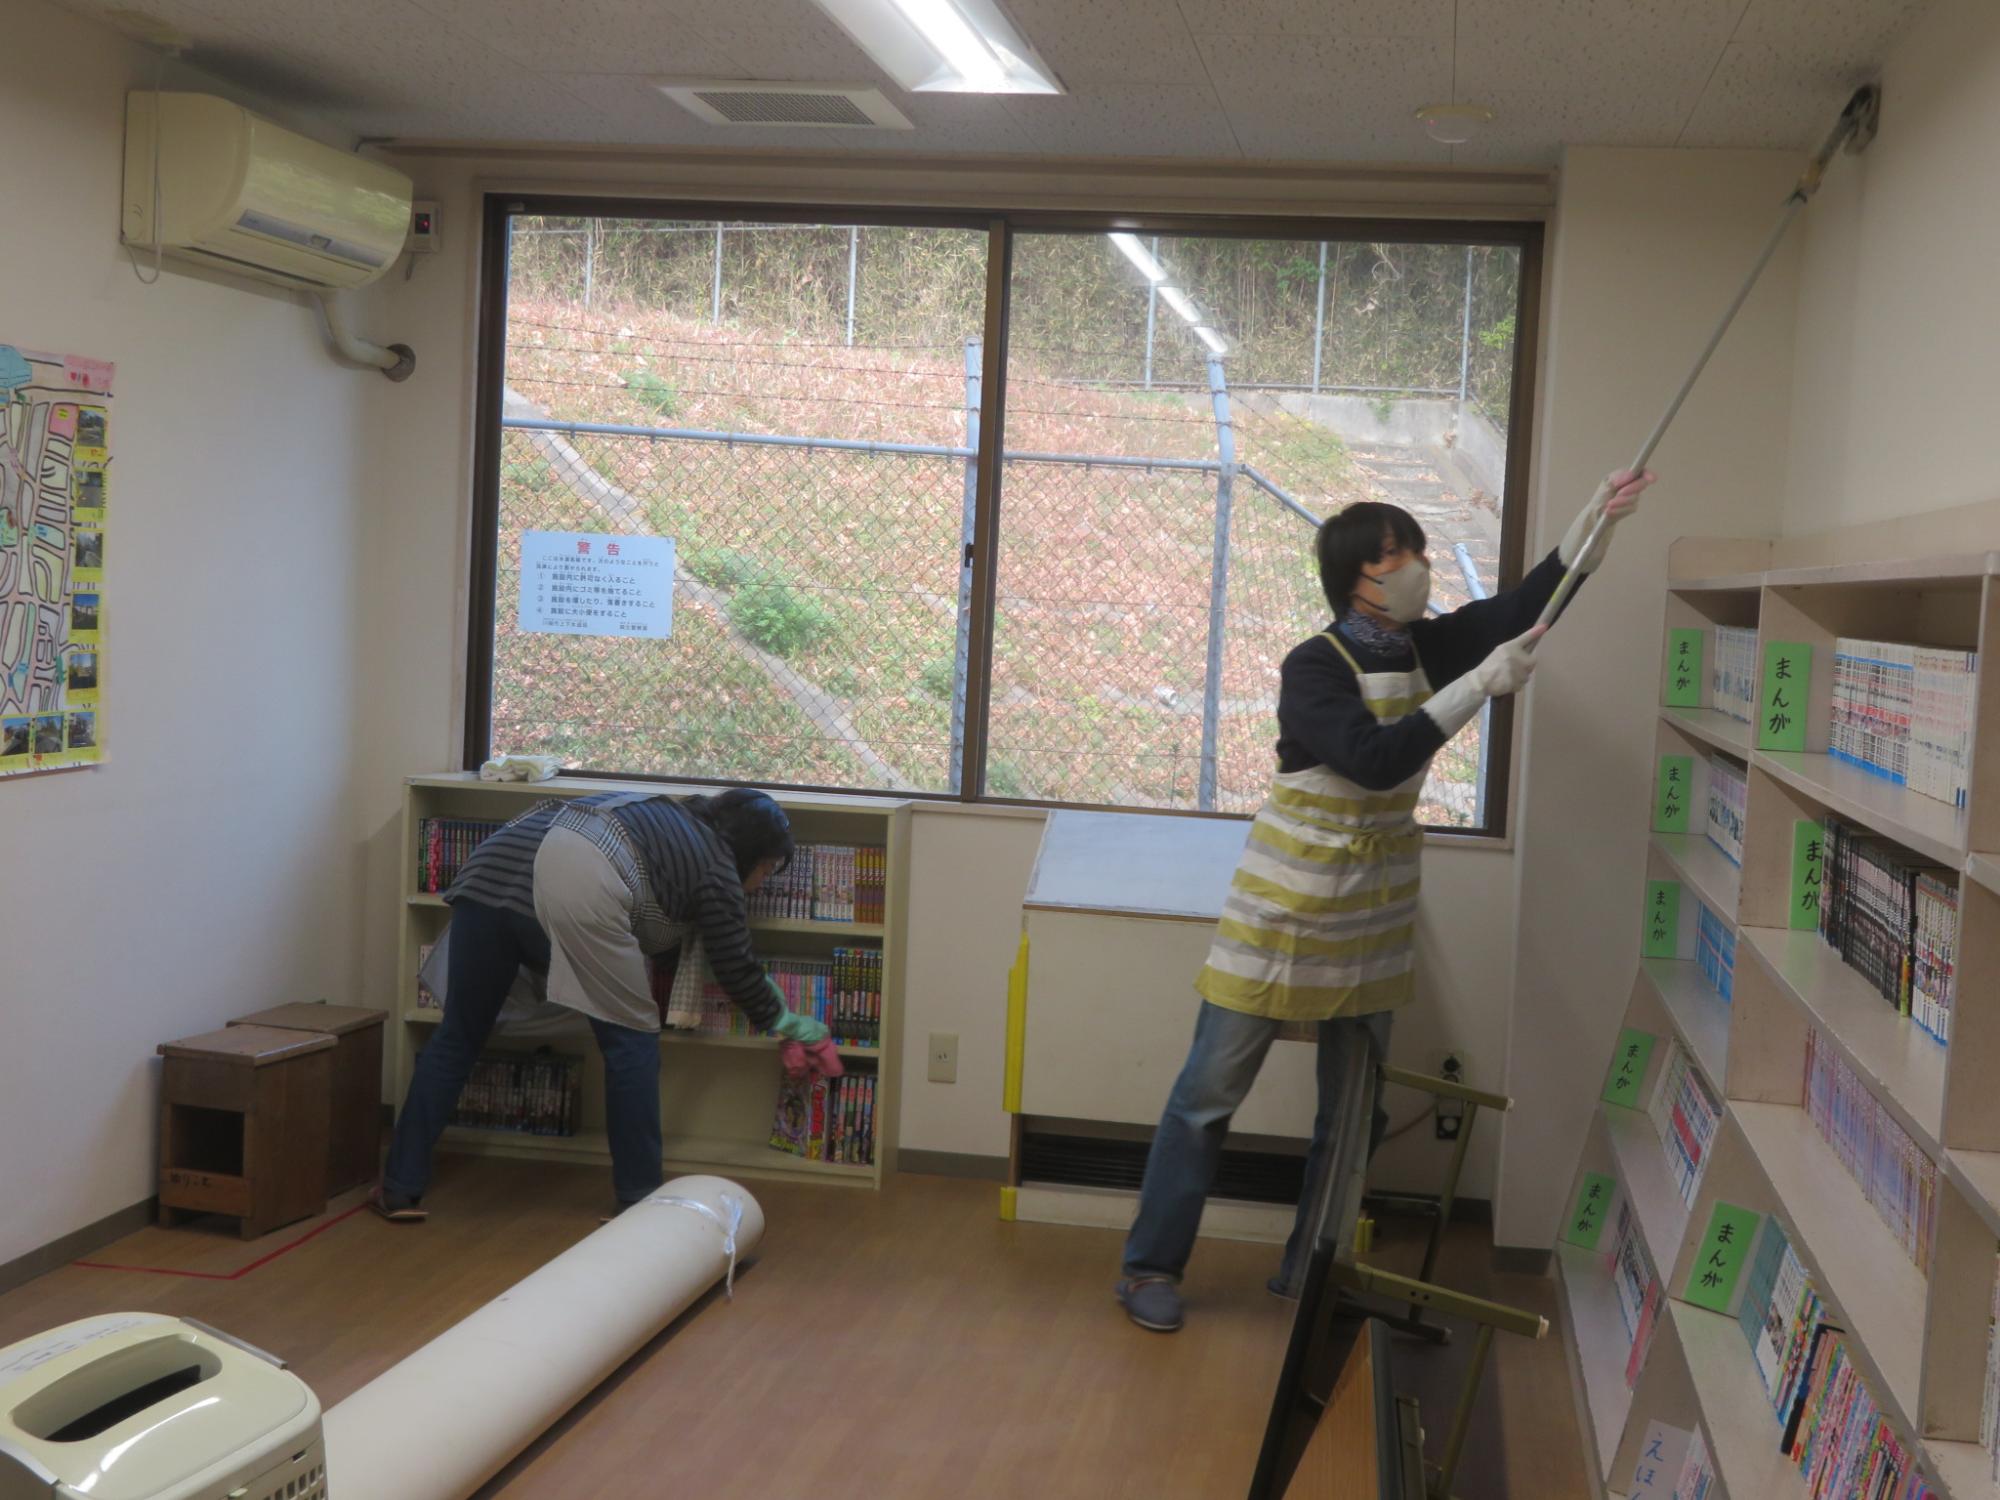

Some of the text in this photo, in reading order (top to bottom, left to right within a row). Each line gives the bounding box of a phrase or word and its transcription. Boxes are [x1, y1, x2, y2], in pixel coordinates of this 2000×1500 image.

[576, 540, 620, 556] 警告
[1676, 640, 1691, 691] まんが
[1768, 657, 1792, 735] まんが
[1663, 766, 1682, 819] まんが
[1801, 840, 1823, 911] まんが
[1652, 889, 1668, 942] まんが
[1615, 1044, 1640, 1090] まんが
[1576, 1183, 1601, 1233] まんが
[1699, 1223, 1735, 1290] まんが
